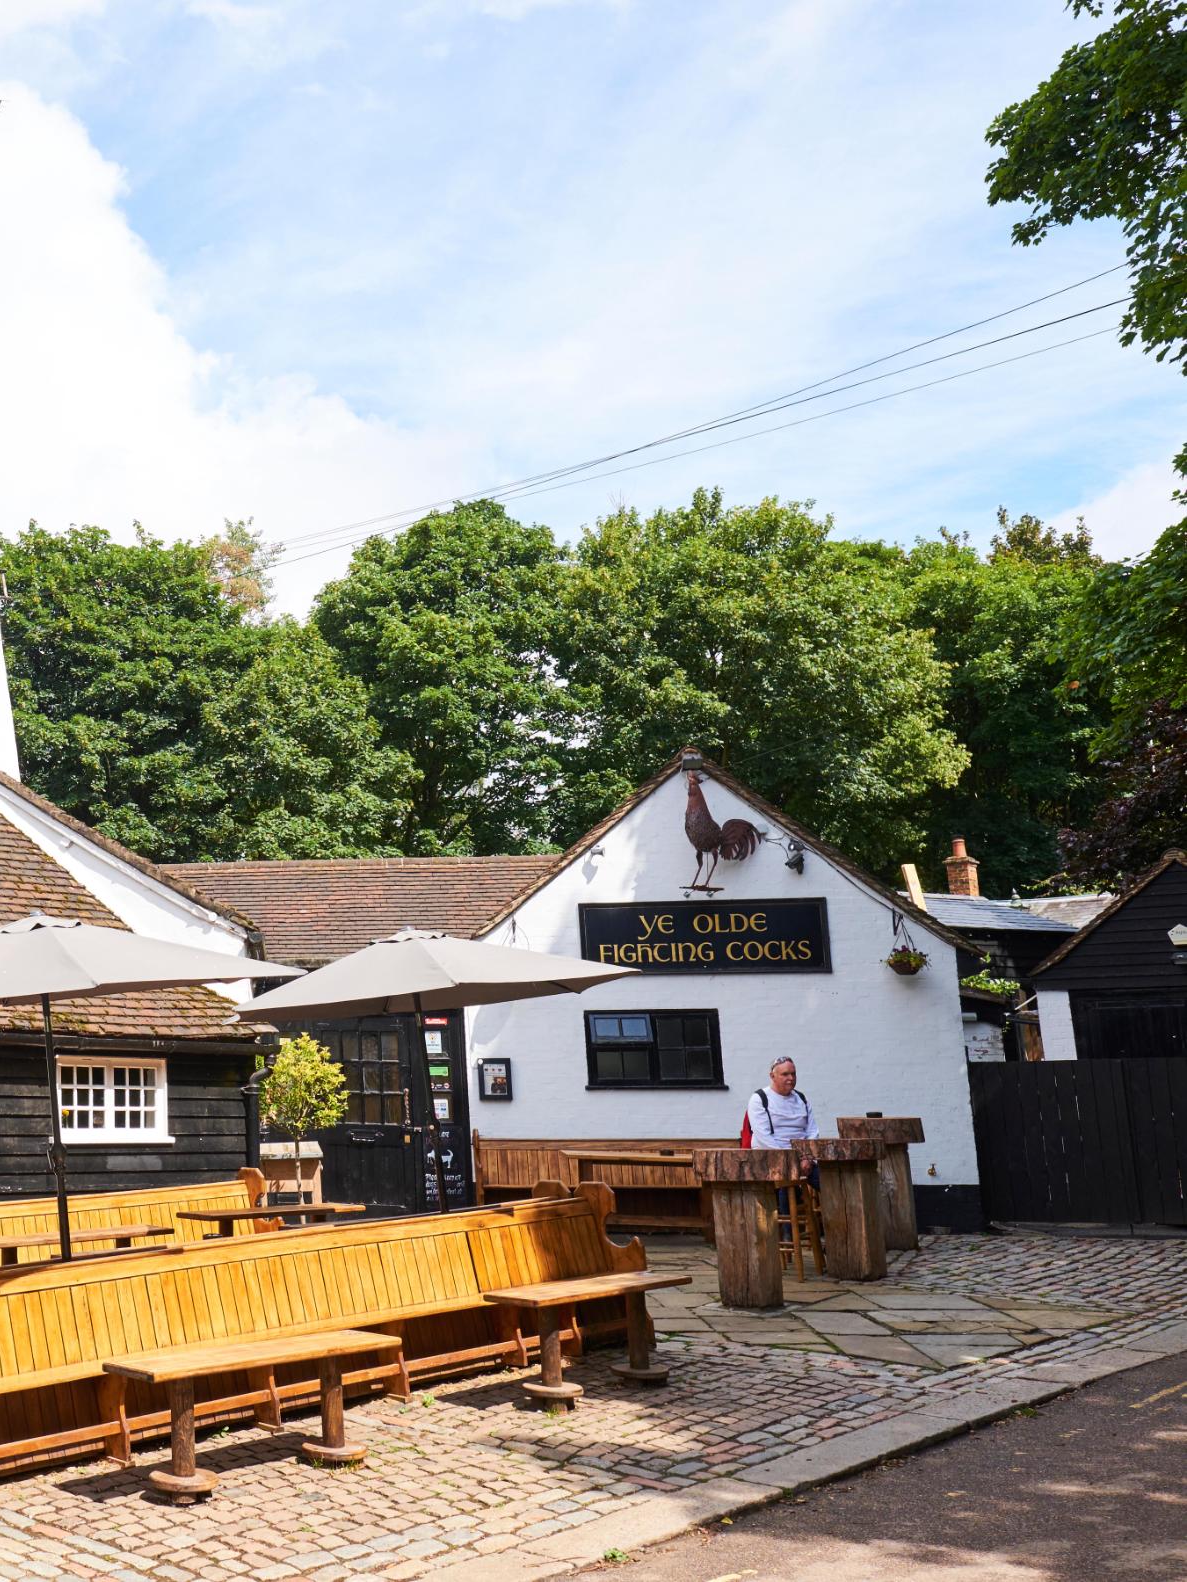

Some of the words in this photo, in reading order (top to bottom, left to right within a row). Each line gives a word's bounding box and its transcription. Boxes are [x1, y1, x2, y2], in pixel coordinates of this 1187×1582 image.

[638, 914, 675, 941] YE
[693, 912, 768, 934] OLDE
[599, 941, 715, 964] FIGHTING
[726, 940, 812, 961] COCKS
